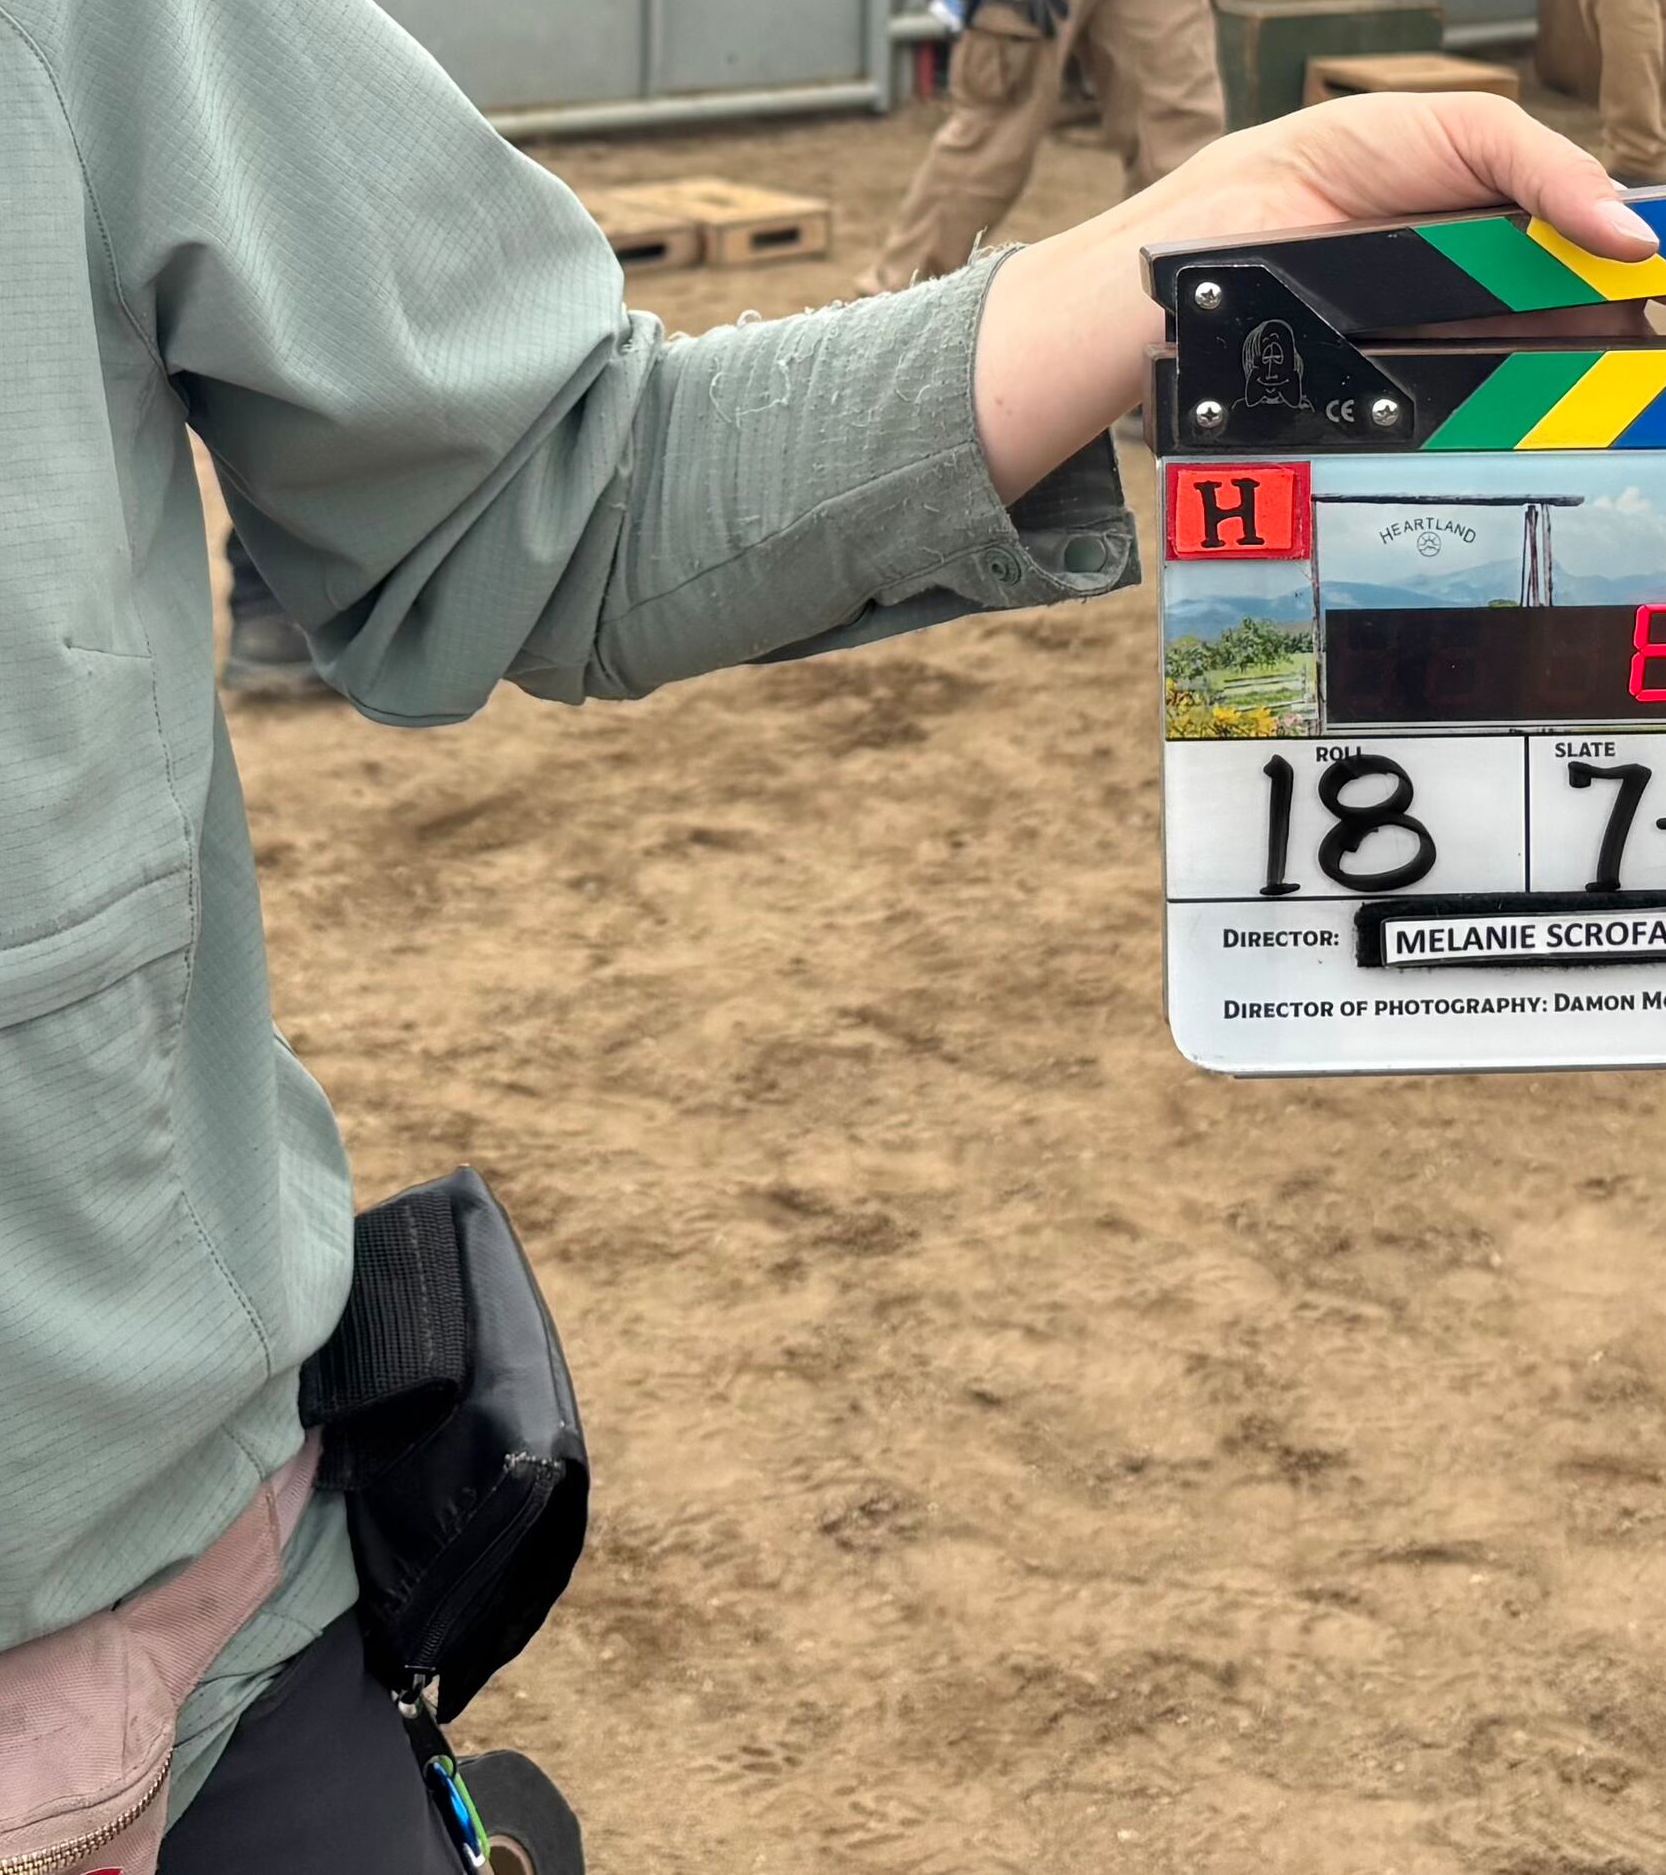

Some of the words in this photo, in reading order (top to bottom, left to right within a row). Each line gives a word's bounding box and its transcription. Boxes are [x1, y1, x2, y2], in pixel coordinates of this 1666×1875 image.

[1193, 477, 1265, 548] H
[1379, 517, 1477, 545] HEARTLAND
[1554, 742, 1616, 758] SLATE
[1260, 753, 1437, 895] 18
[1395, 923, 1536, 955] MELANIE
